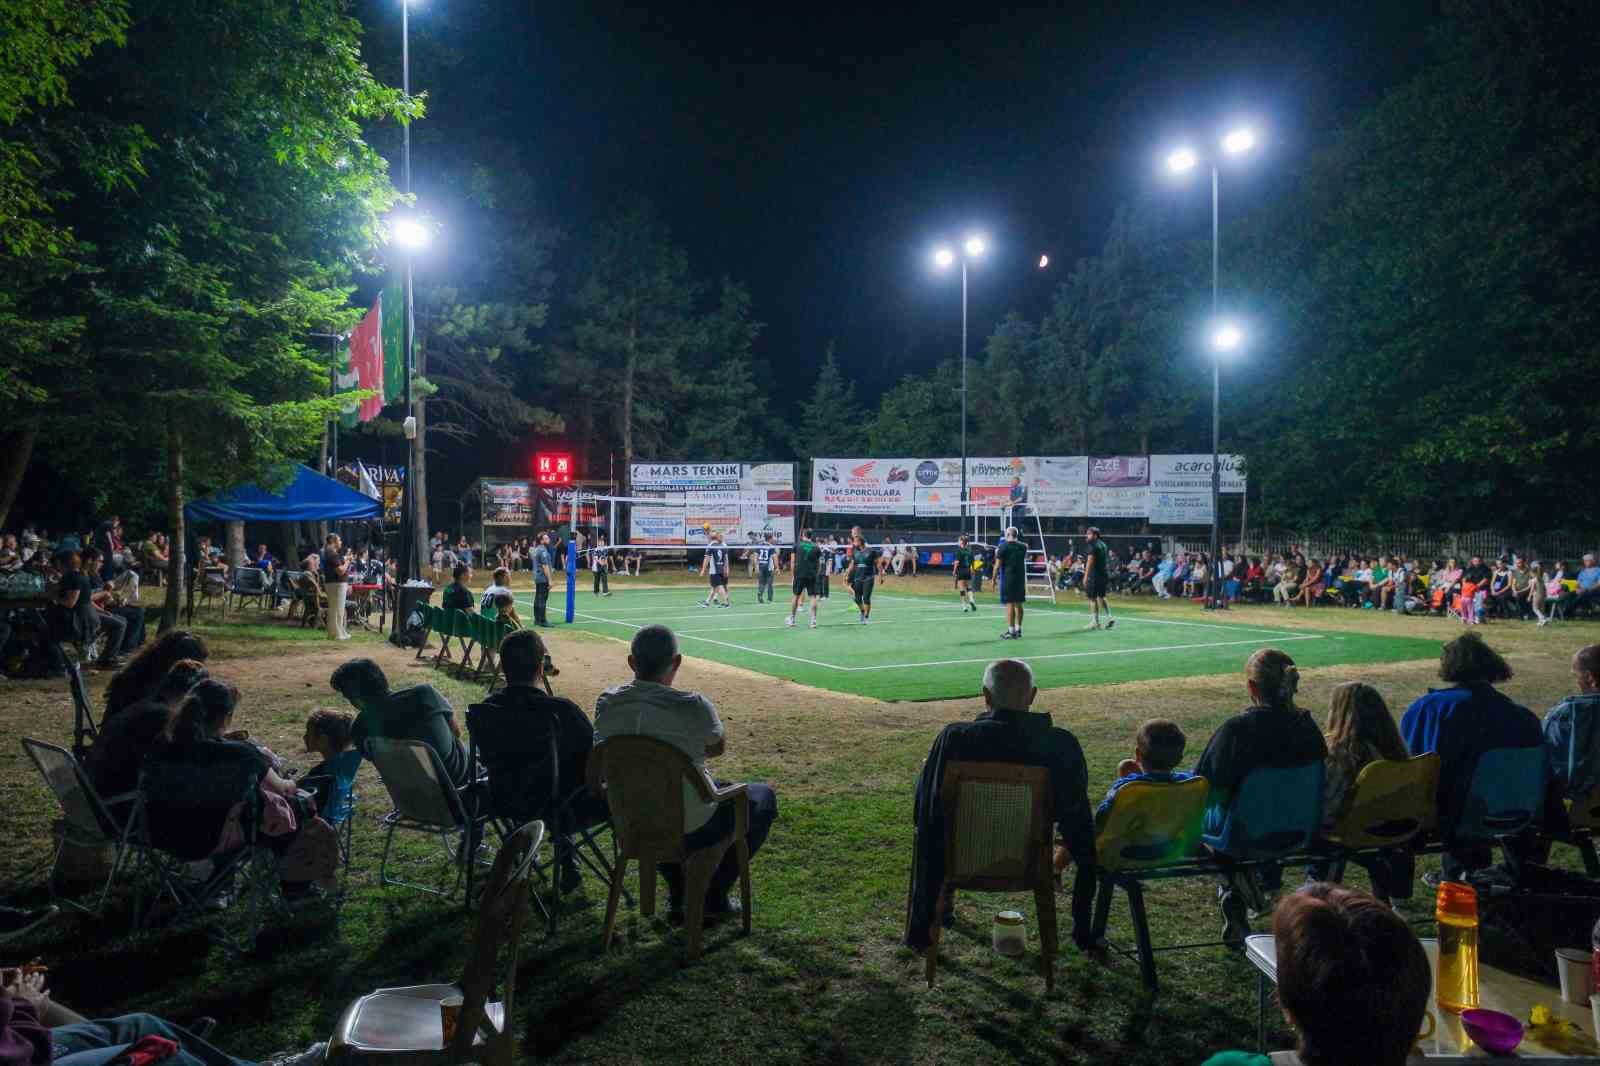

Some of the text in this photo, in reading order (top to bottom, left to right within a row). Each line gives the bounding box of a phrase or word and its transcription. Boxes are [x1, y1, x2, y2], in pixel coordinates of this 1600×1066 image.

[650, 466, 688, 476] MARS
[844, 488, 901, 496] SPORCULARA
[759, 549, 769, 560] 23
